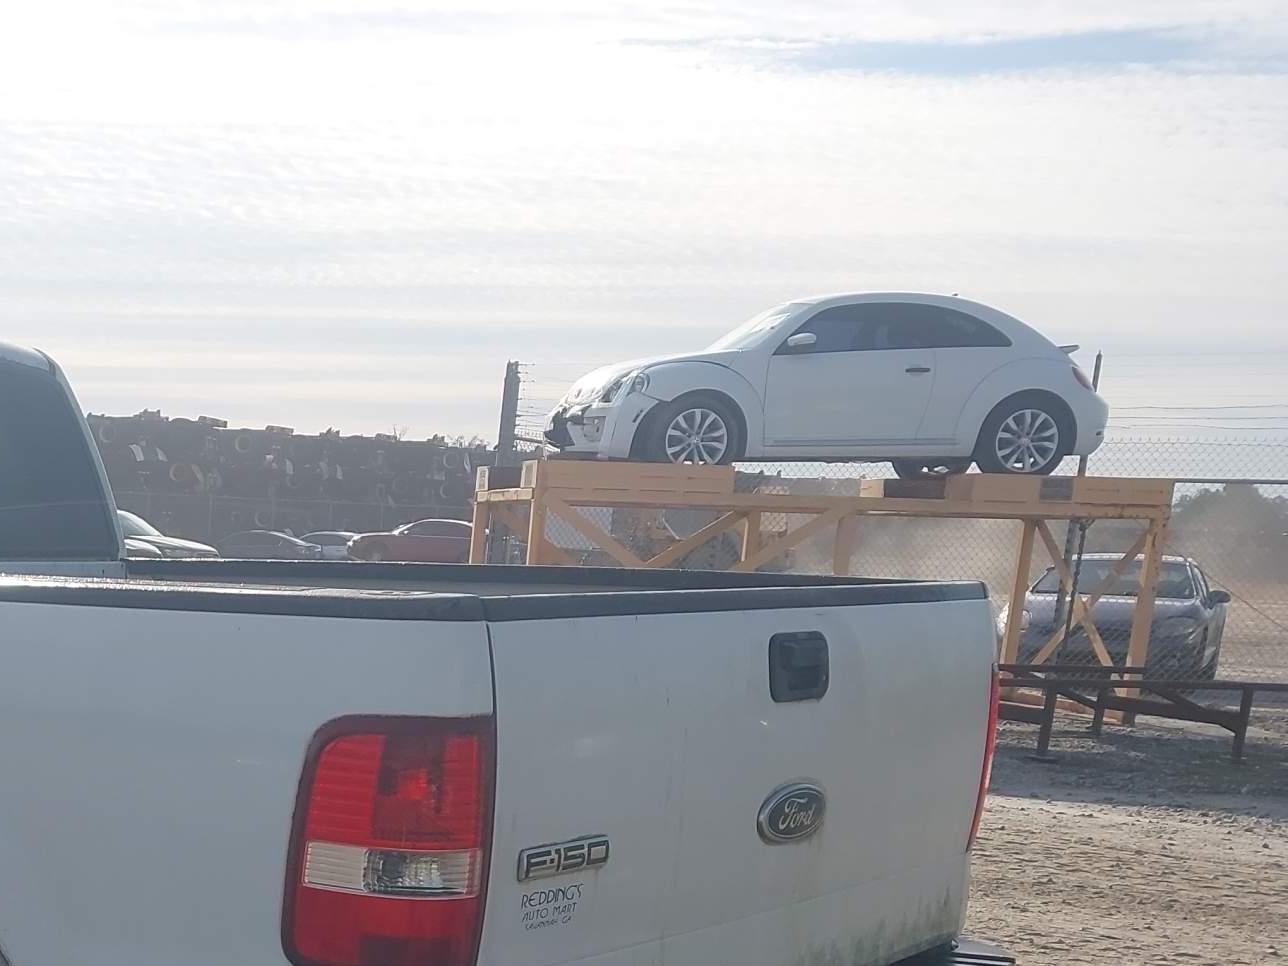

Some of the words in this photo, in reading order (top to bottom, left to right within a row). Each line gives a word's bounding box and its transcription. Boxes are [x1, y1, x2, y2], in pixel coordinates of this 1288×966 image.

[778, 797, 816, 830] Ford
[524, 839, 610, 879] F-150
[522, 907, 549, 922] AUTO
[552, 902, 577, 917] MART
